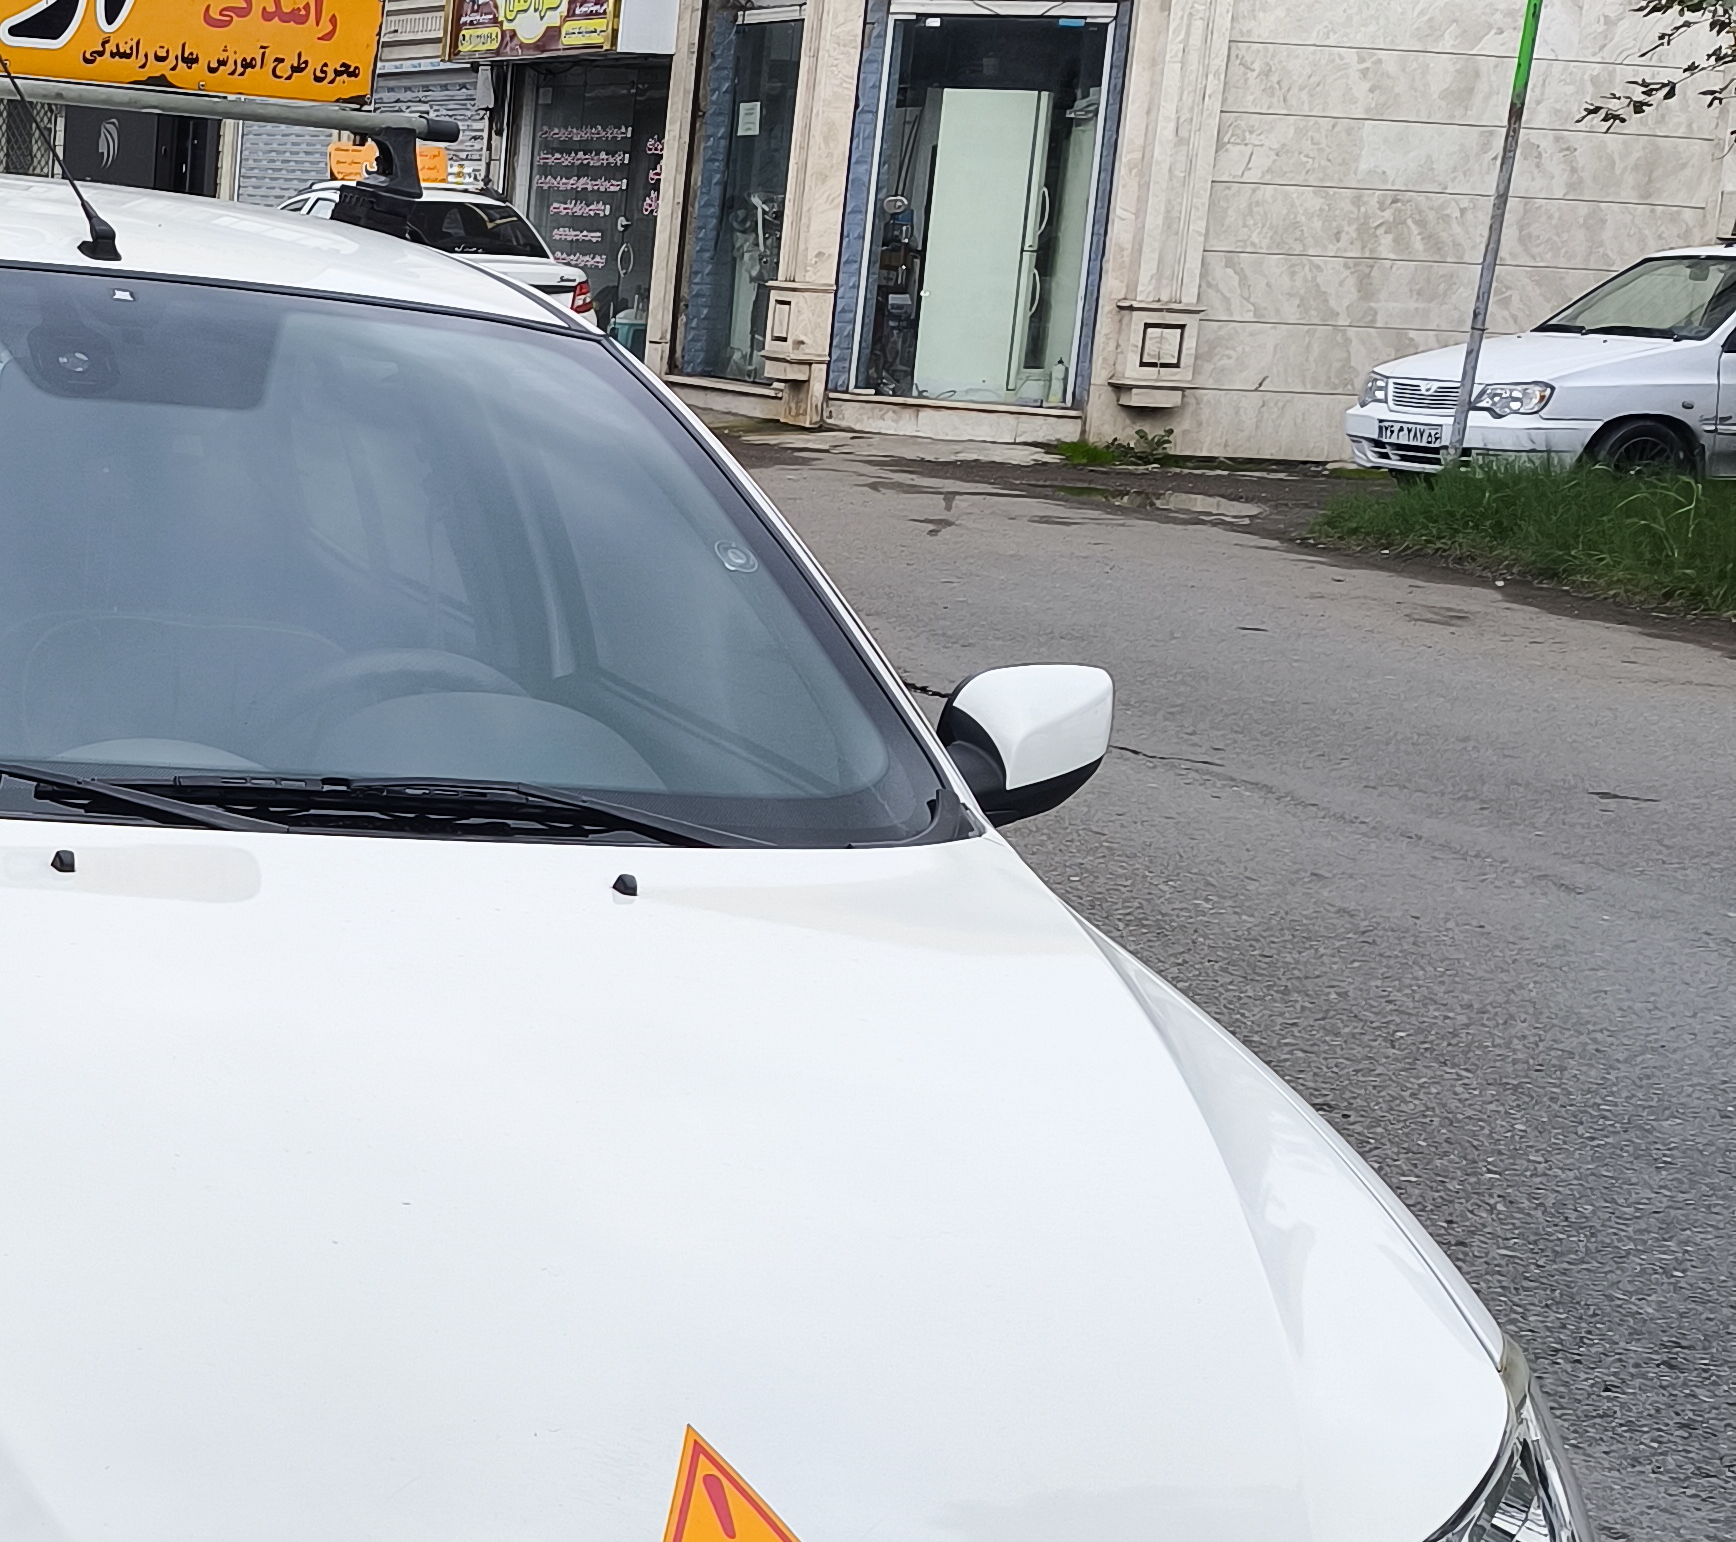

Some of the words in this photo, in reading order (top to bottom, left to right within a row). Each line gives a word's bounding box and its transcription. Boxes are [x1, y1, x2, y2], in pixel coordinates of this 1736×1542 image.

[82, 36, 149, 69] رانندگی
[153, 41, 200, 72] مهارت
[206, 44, 270, 77] آموزش
[271, 51, 309, 80] طرح
[312, 55, 361, 85] مجری
